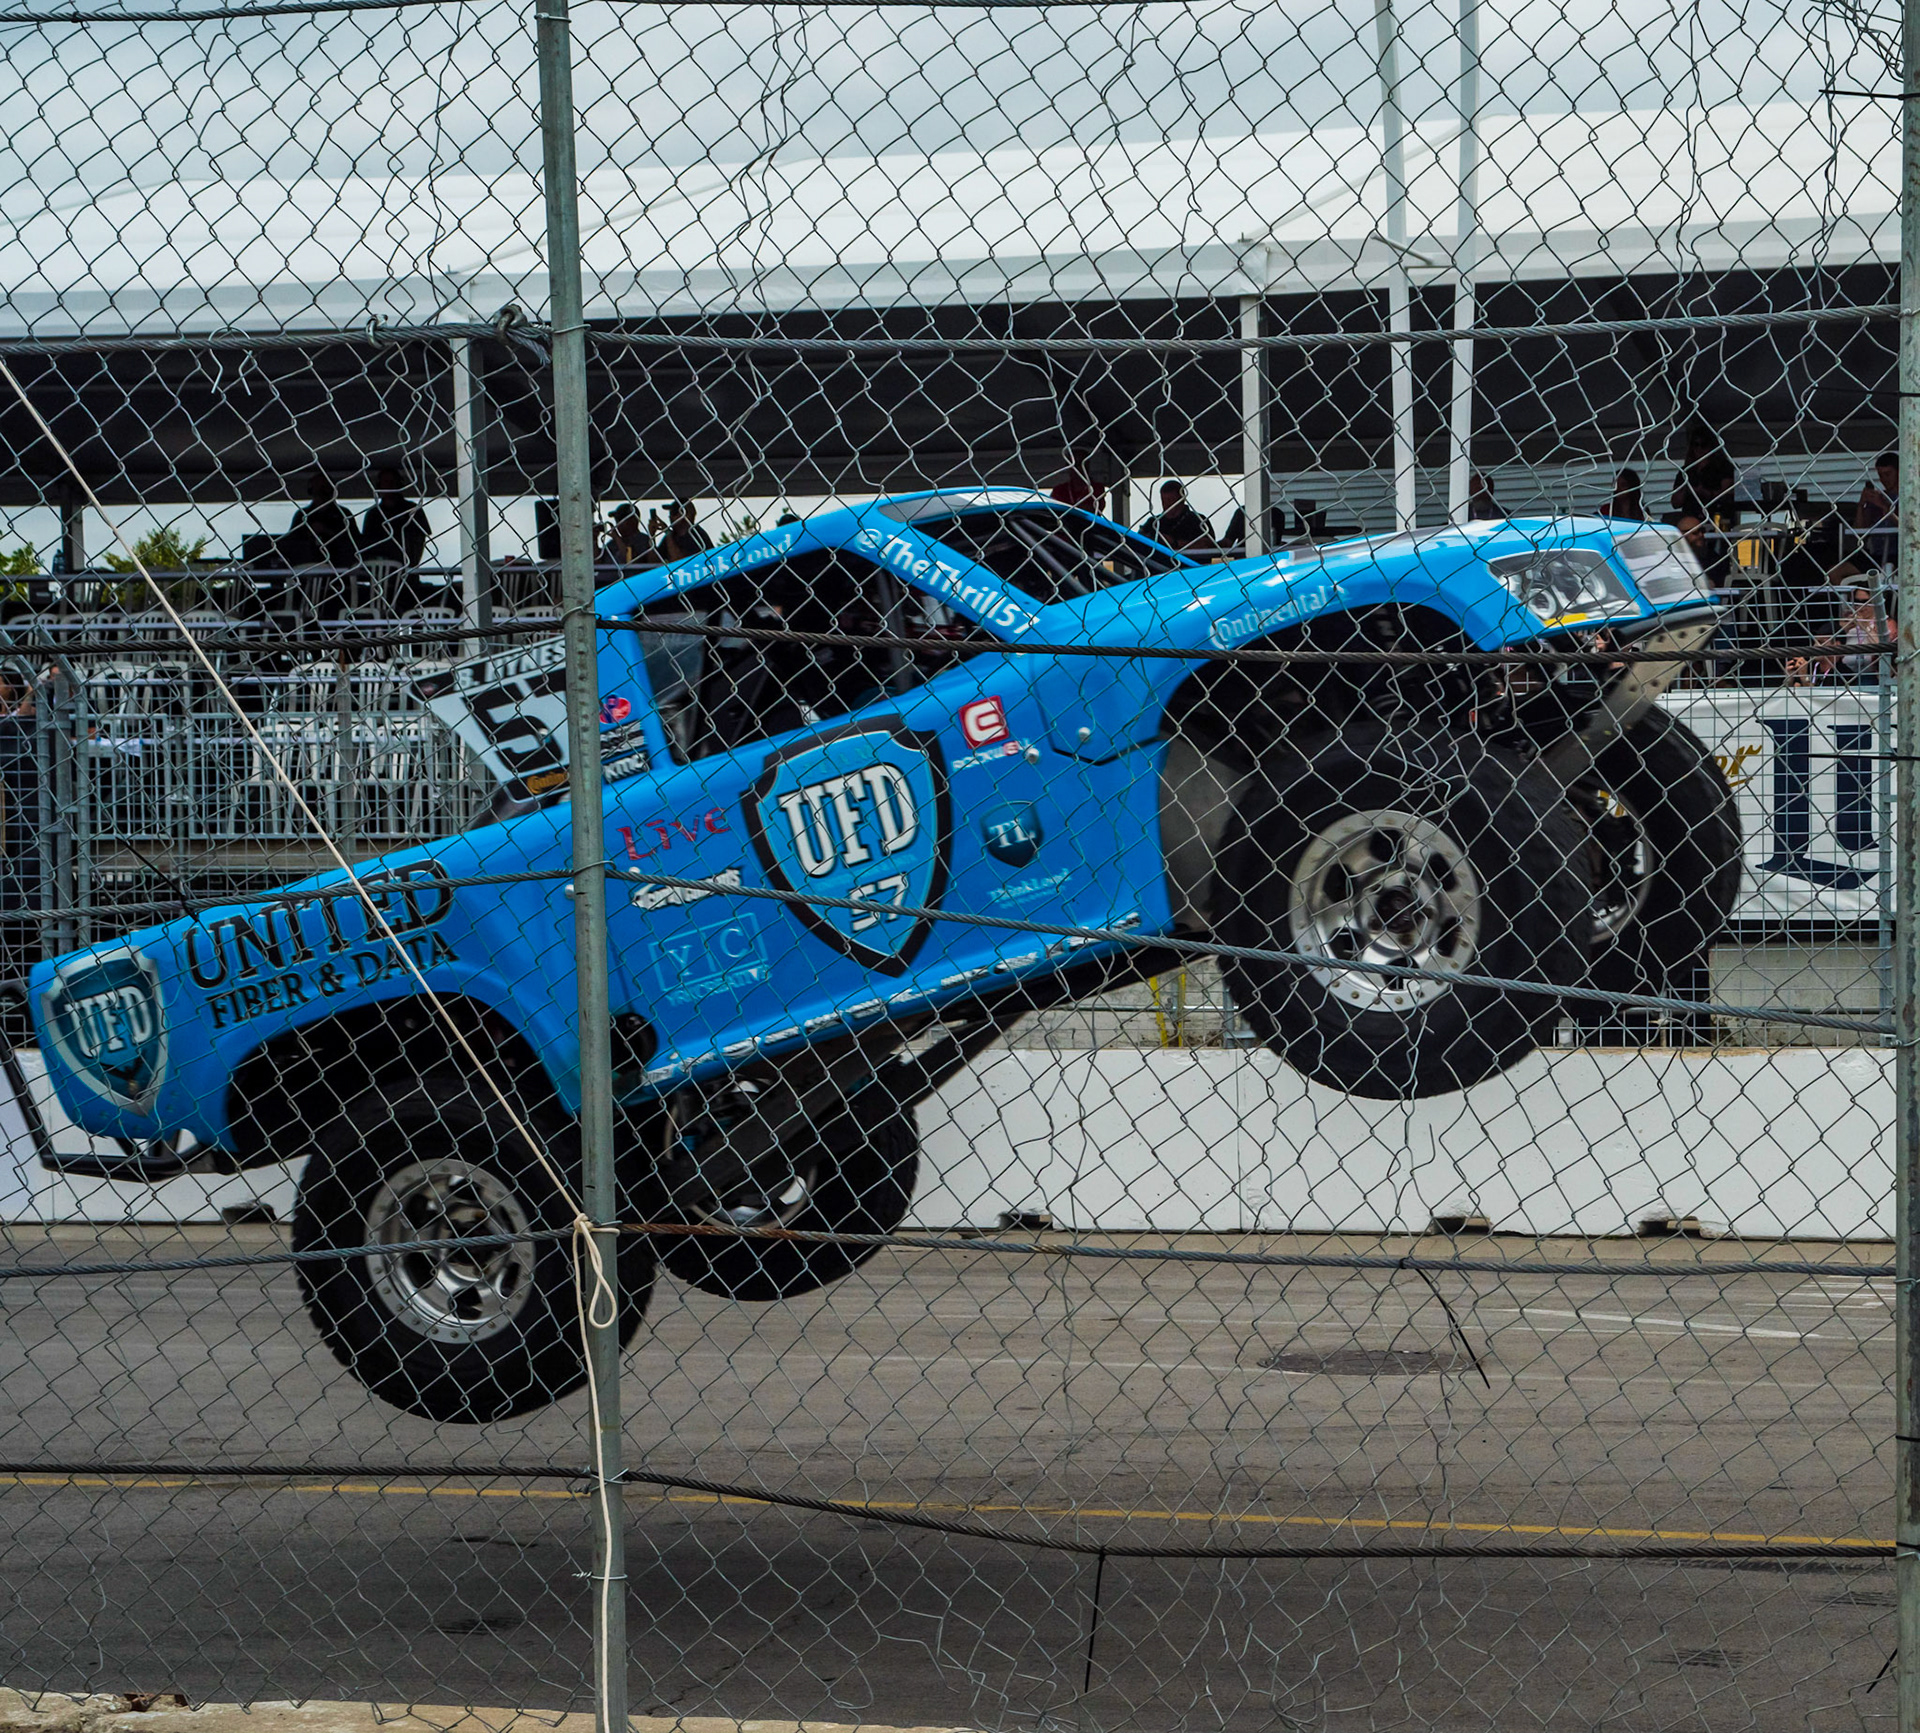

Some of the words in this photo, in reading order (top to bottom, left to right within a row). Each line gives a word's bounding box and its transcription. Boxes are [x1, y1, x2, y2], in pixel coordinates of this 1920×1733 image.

[856, 527, 1041, 637] @TheThrill57
[778, 762, 919, 878] UFD
[988, 818, 1036, 848] TL
[1754, 718, 1890, 890] Li
[184, 859, 453, 990] UNITED
[849, 873, 909, 933] 57
[64, 985, 154, 1059] UFD
[205, 975, 309, 1029] FIBER
[318, 960, 344, 997] &
[352, 930, 460, 989] DATA
